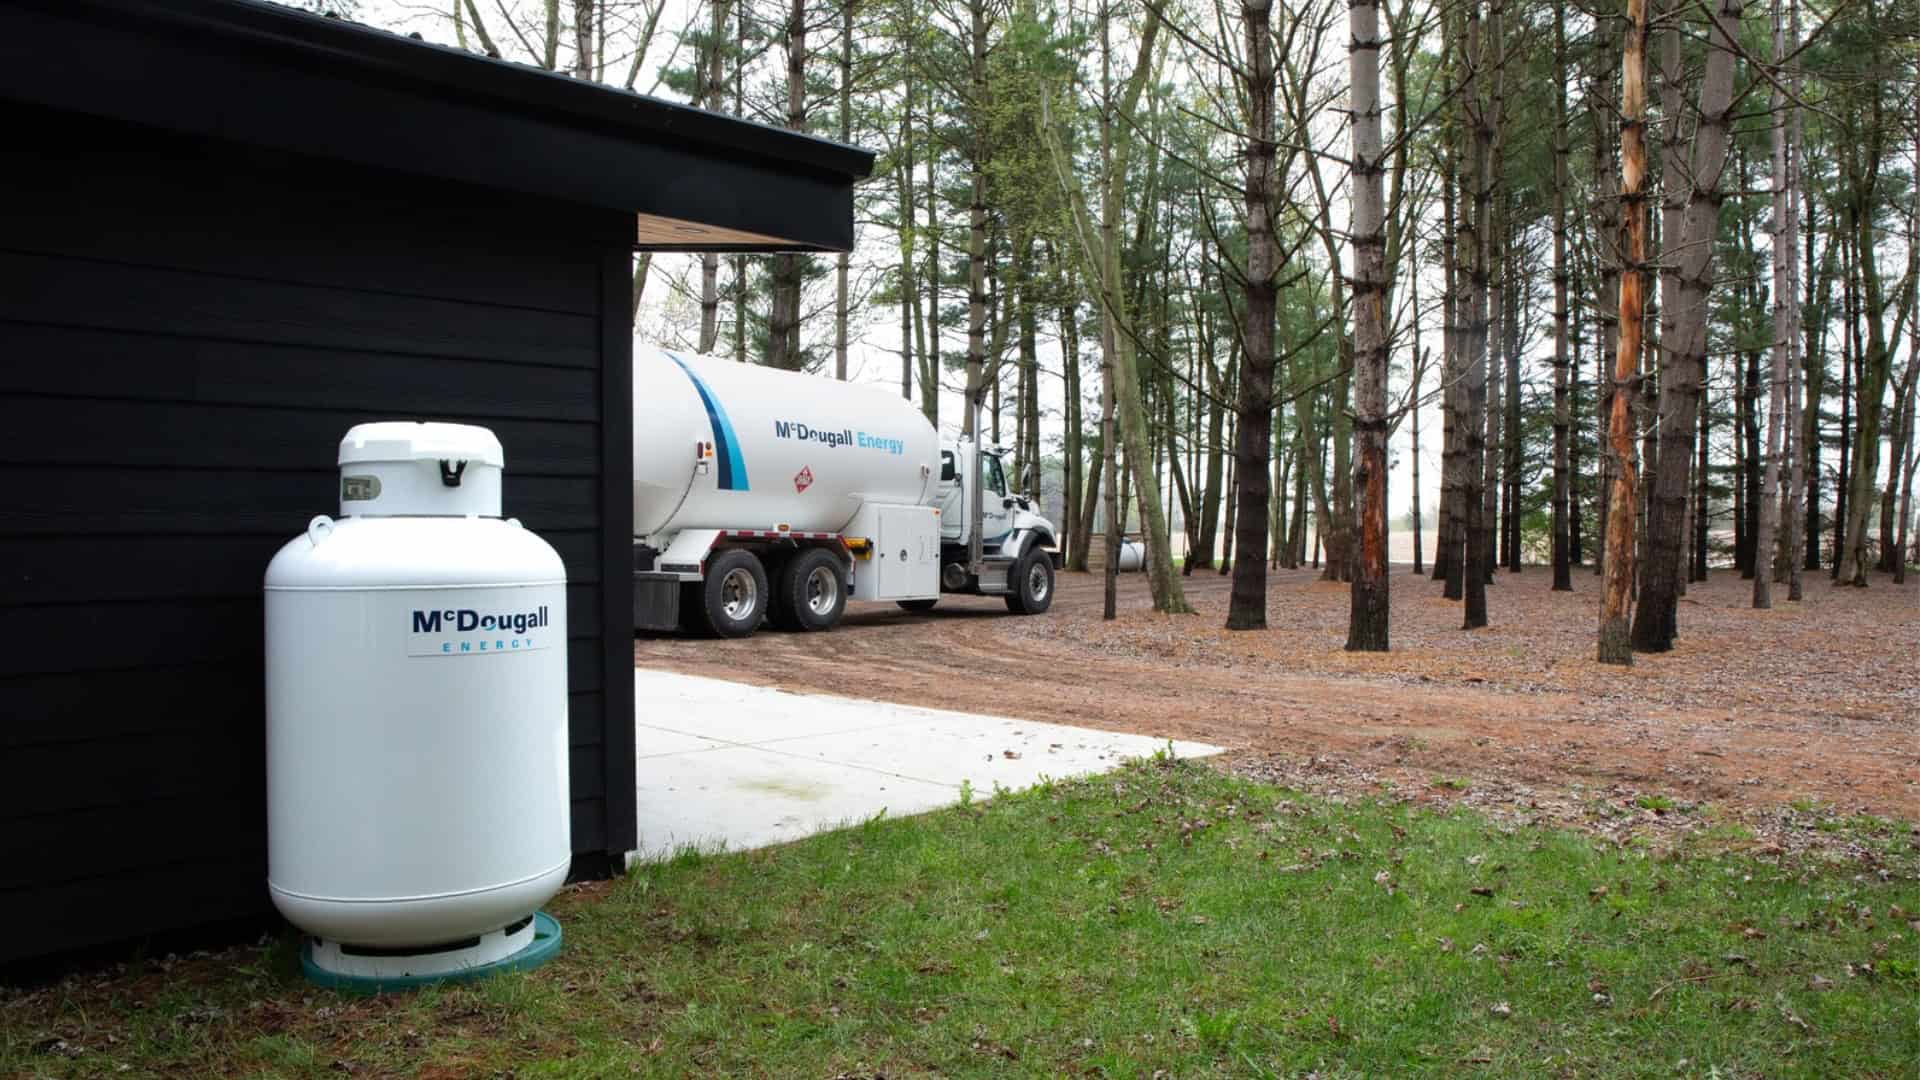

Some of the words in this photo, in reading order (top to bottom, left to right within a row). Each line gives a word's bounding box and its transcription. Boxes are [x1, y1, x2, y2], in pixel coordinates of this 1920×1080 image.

[775, 420, 853, 448] McDougall
[857, 431, 904, 455] Energy
[413, 605, 548, 634] McDougall
[442, 639, 532, 652] ENERGY
